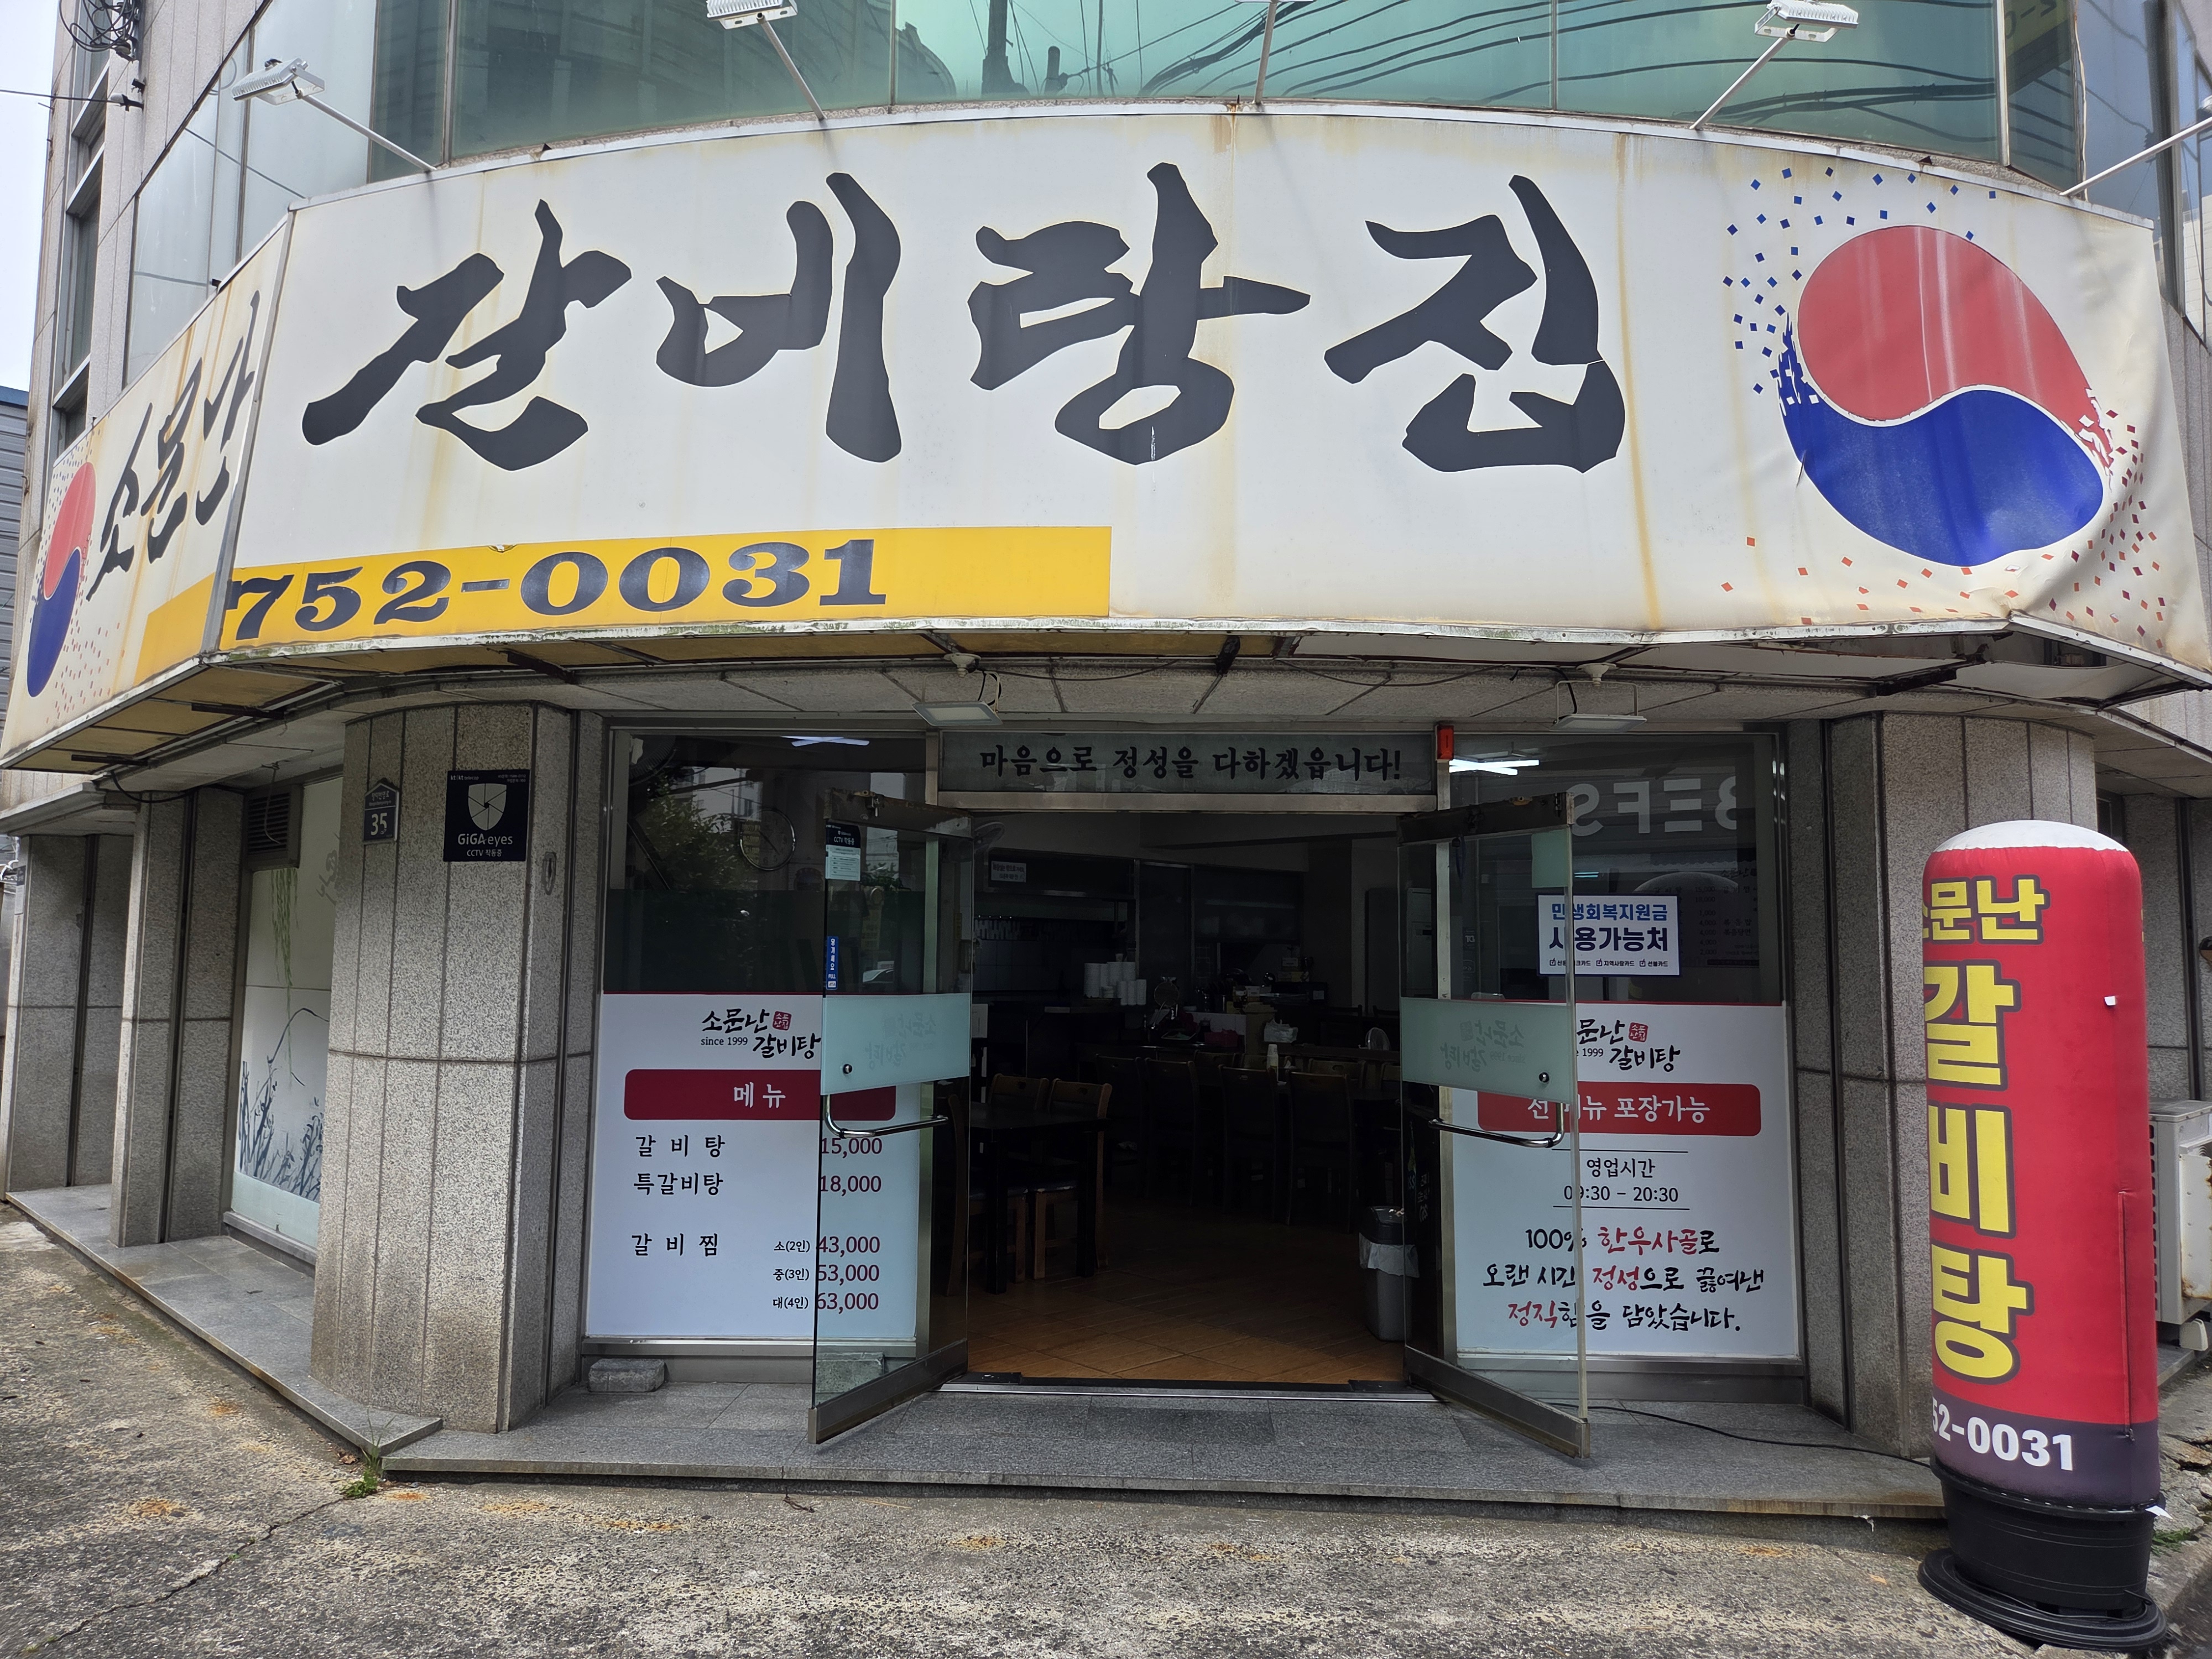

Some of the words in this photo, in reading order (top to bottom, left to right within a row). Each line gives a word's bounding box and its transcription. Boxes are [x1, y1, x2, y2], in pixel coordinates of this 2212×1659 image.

[302, 162, 1625, 473] 갈비탕집
[226, 538, 886, 640] 752-0031
[980, 745, 1098, 778] 마음으로
[1113, 747, 1199, 780] 정성을
[1212, 747, 1401, 781] 다하겠읍니다!
[371, 812, 388, 836] 35
[485, 849, 503, 857] 작동중
[1922, 878, 2044, 940] 문난
[701, 1008, 770, 1033] 소문난
[701, 1036, 724, 1046] since
[727, 1036, 748, 1047] 1999
[753, 1033, 822, 1060] 갈비탕
[1582, 1048, 1604, 1058] 1999
[1609, 1045, 1680, 1072] 갈비탕
[1614, 1095, 1710, 1123] 포장가능
[820, 1137, 883, 1158] 15,000
[1586, 1158, 1656, 1179] 영업시간
[633, 1172, 724, 1196] 특갈비탕
[819, 1175, 882, 1196] 18,000
[1632, 1186, 1679, 1203] 20:30
[774, 1239, 811, 1254] 소(2인)
[817, 1236, 880, 1258] 43,000
[1597, 1226, 1720, 1256] 한우사골로
[773, 1267, 810, 1282] 중(3인)
[817, 1264, 880, 1286] 53,000
[1483, 1263, 1529, 1287] 오랜
[1537, 1265, 1575, 1287] 시간
[1592, 1265, 1684, 1292] 정성으로
[1696, 1267, 1764, 1293] 끓여낸
[773, 1296, 809, 1311] 대(4인)
[816, 1292, 879, 1314] 63,000
[1622, 1303, 1741, 1331] 담았습니다.
